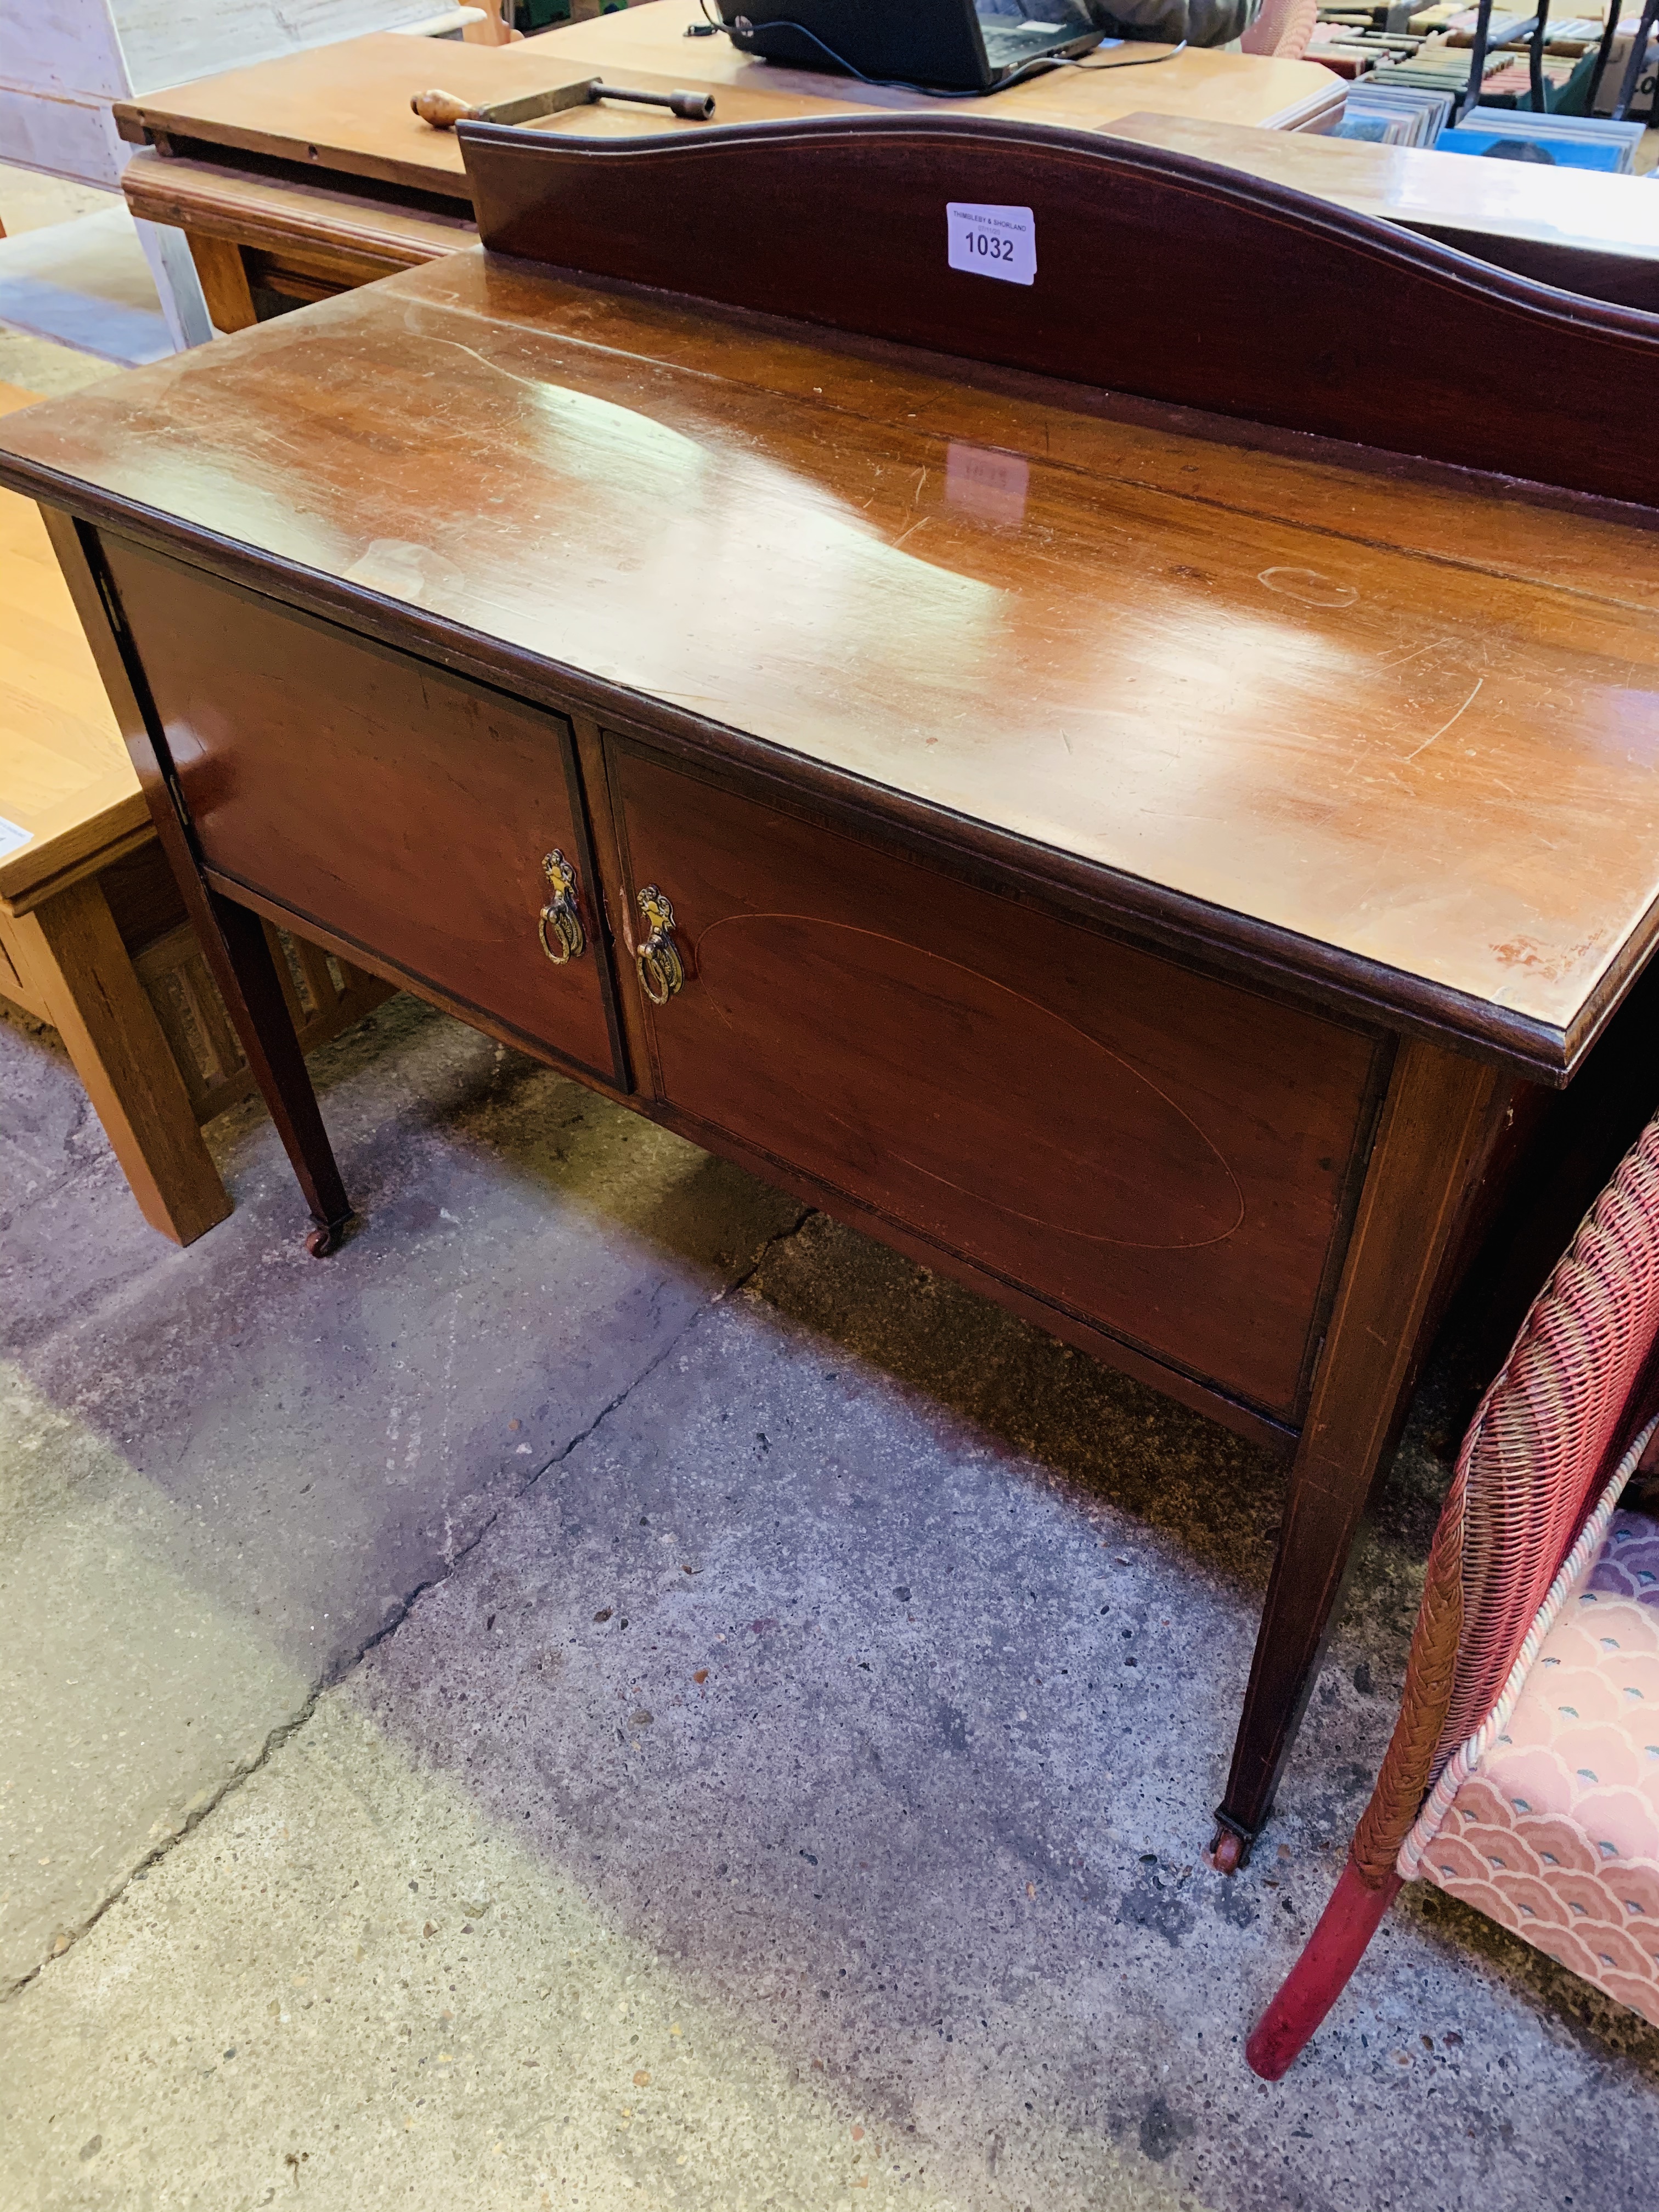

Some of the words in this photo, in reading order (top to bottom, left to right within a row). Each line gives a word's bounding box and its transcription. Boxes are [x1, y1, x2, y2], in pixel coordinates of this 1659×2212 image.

[953, 211, 986, 223] THIMBLEBY
[994, 219, 1026, 232] SHORLAND
[966, 232, 1013, 262] 1032
